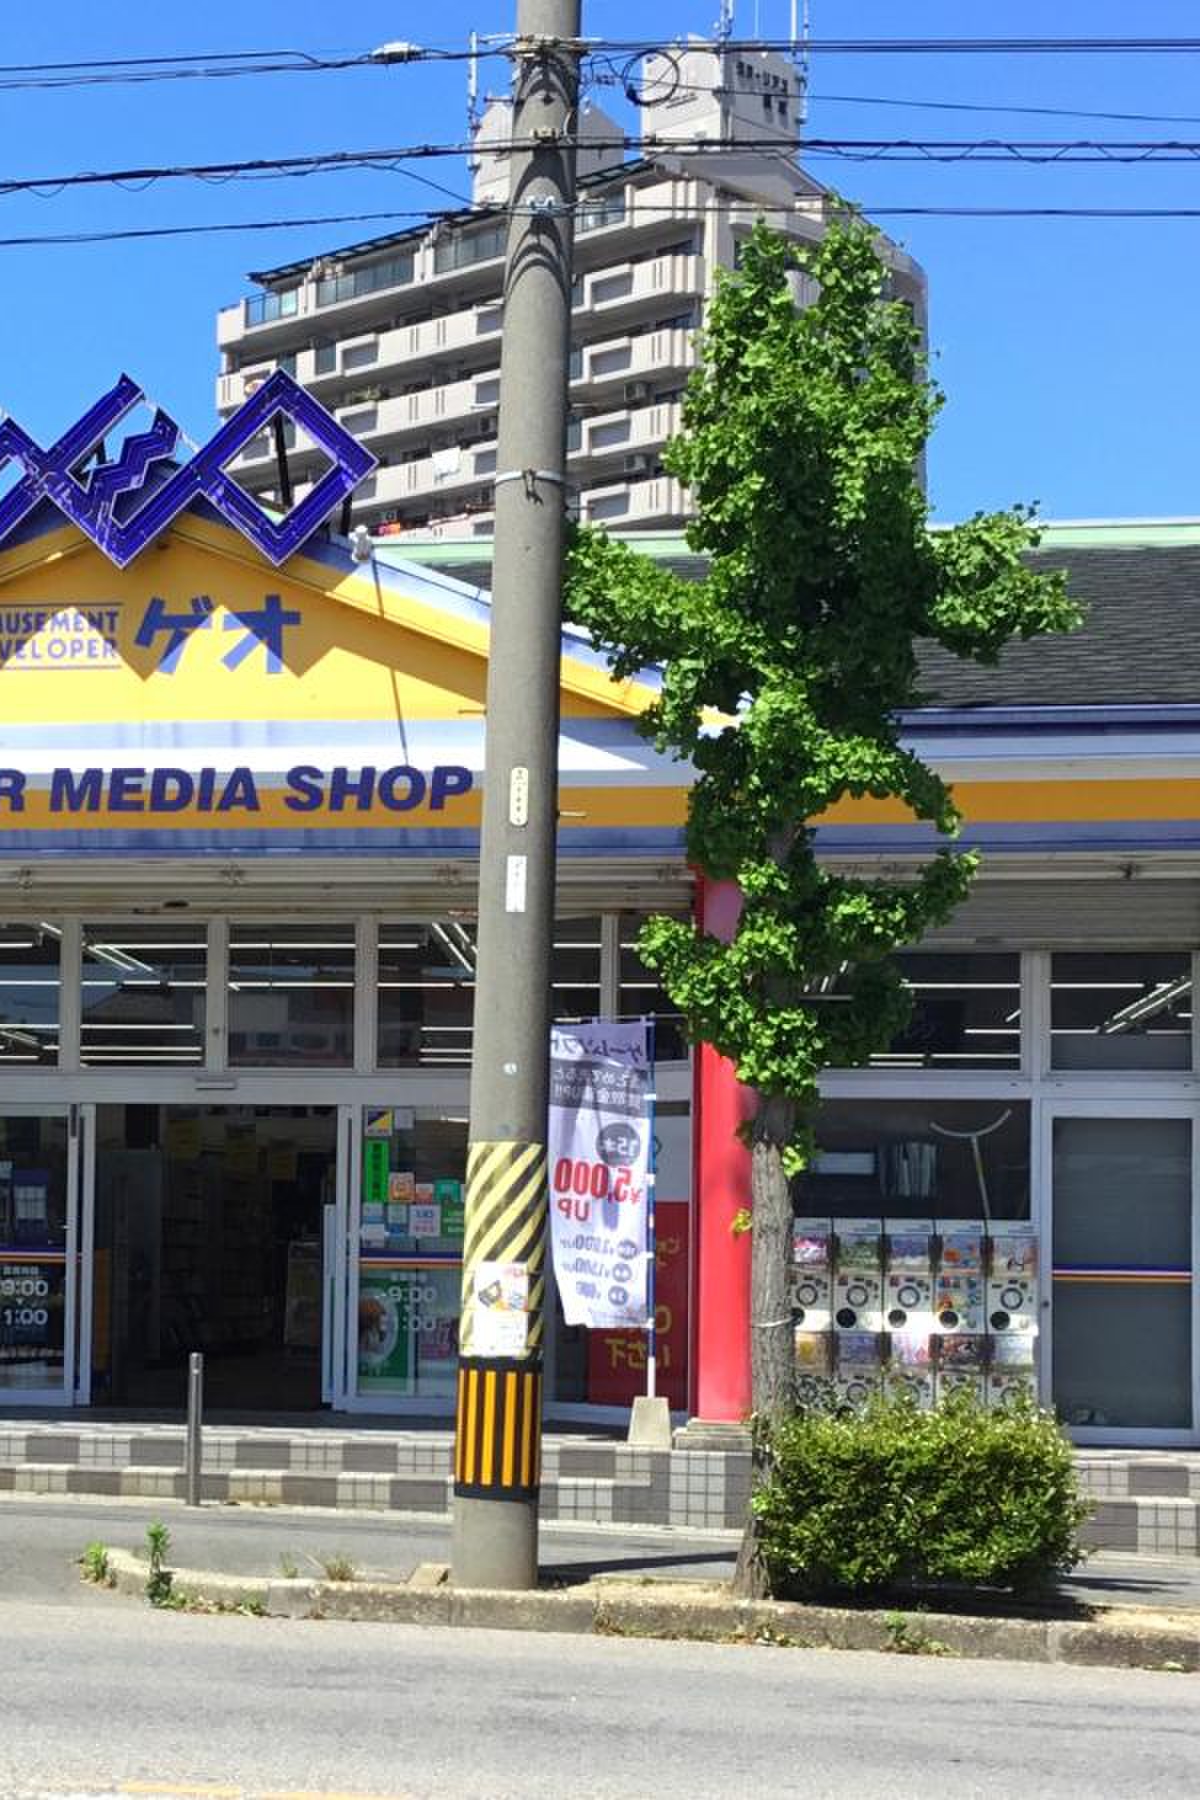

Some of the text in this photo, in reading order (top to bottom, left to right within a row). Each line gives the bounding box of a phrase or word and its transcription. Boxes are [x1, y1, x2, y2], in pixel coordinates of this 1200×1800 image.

[134, 594, 302, 675] ゲオ
[49, 767, 261, 813] MEDIA
[283, 765, 474, 812] SHOP
[1, 1280, 49, 1296] 9:00
